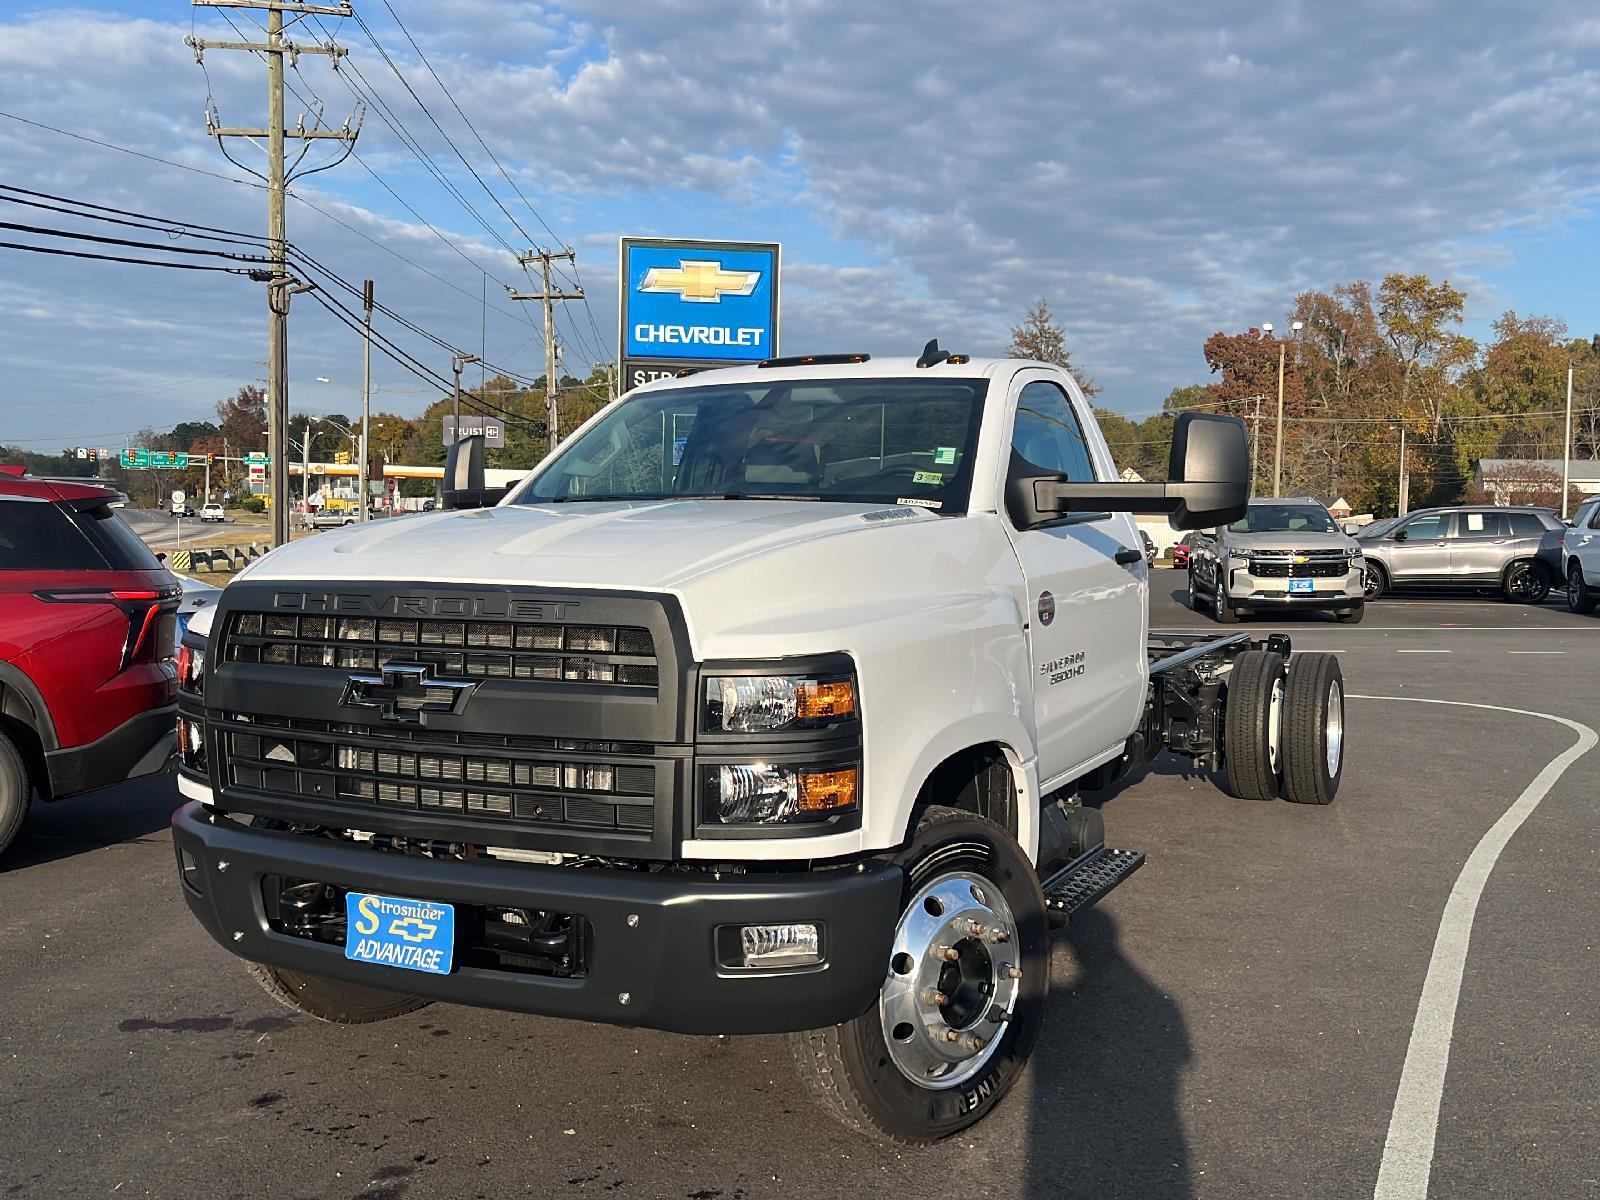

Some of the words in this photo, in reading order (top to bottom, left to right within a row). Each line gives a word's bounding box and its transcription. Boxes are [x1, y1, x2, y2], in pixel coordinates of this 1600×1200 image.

[635, 324, 765, 346] CHEVROLET
[274, 592, 581, 620] CHEVROLET
[355, 896, 445, 935] Strosnider
[354, 939, 444, 969] ADVANTAGE
